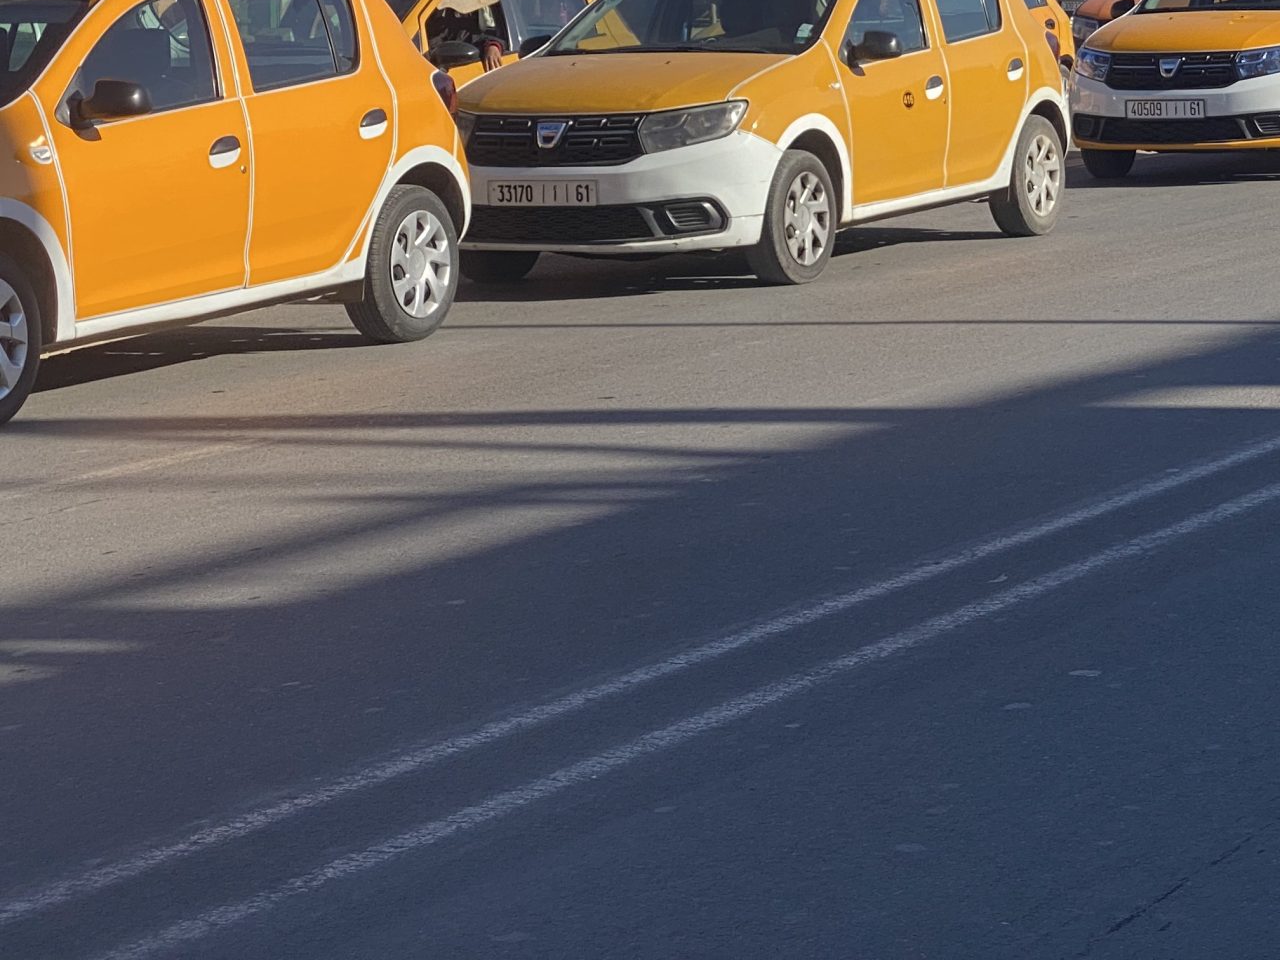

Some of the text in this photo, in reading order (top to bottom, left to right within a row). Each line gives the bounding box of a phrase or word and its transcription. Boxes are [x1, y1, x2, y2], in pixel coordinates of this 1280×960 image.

[1130, 102, 1162, 117] 40509
[1189, 101, 1200, 116] 61
[497, 184, 533, 203] 33170
[575, 184, 590, 203] 61
